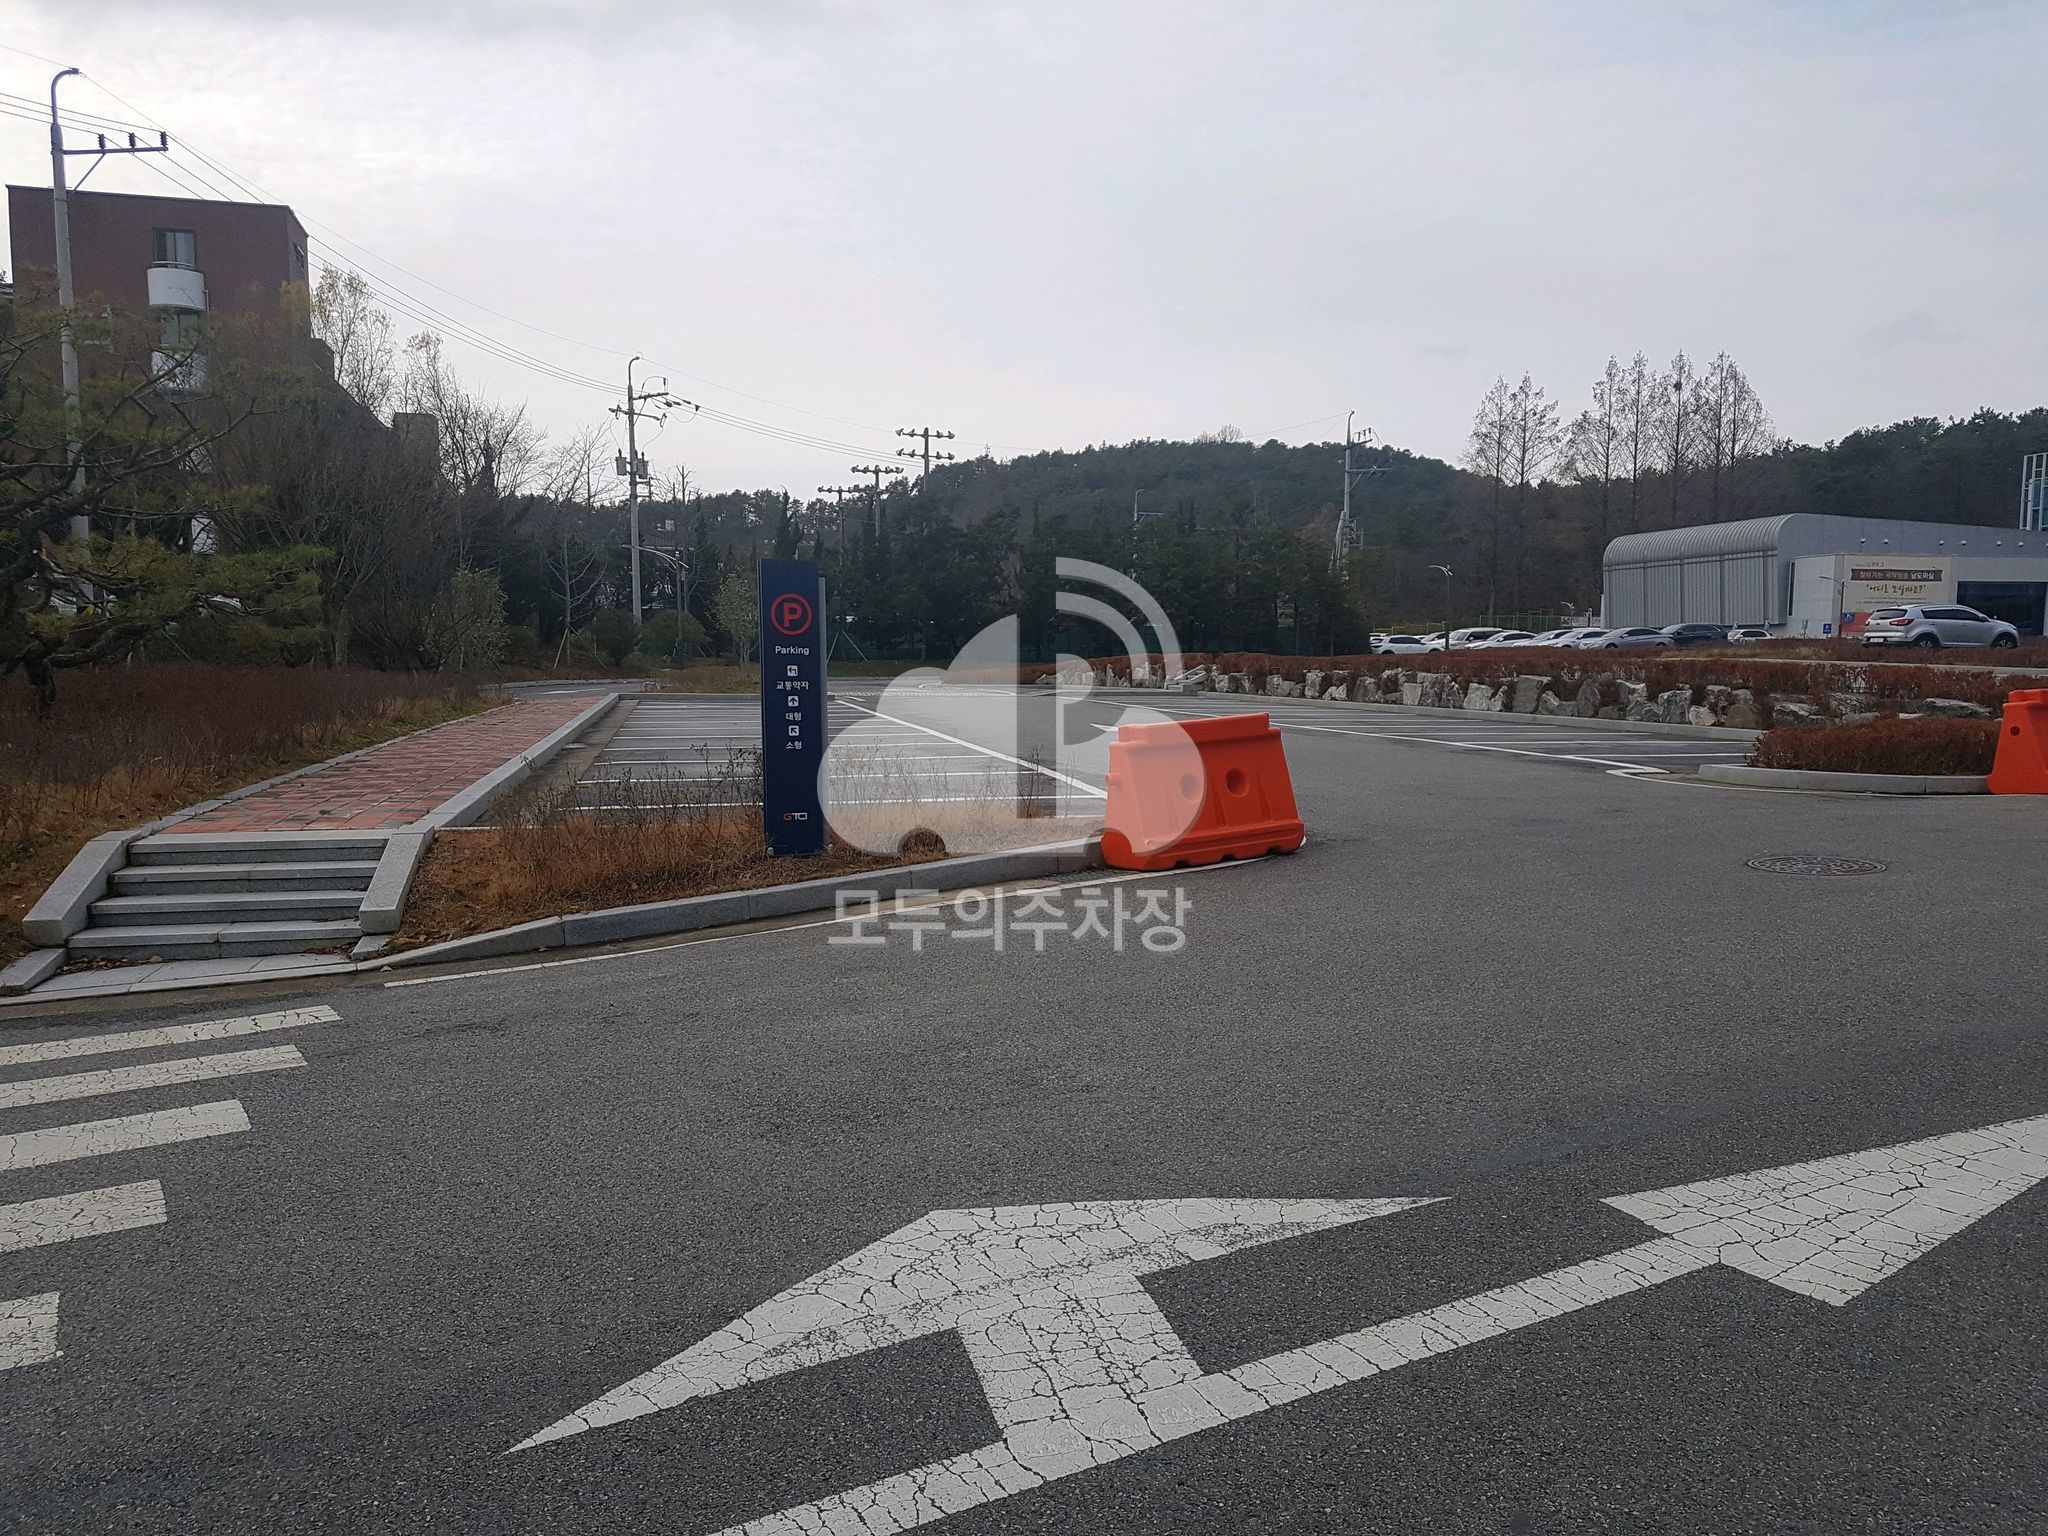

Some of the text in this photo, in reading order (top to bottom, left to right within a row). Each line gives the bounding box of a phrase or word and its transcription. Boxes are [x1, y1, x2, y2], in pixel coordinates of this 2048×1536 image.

[783, 602, 803, 628] P
[775, 645, 810, 656] Parking
[776, 681, 809, 691] 교통약자
[785, 712, 802, 721] 대형
[785, 741, 802, 750] 소형
